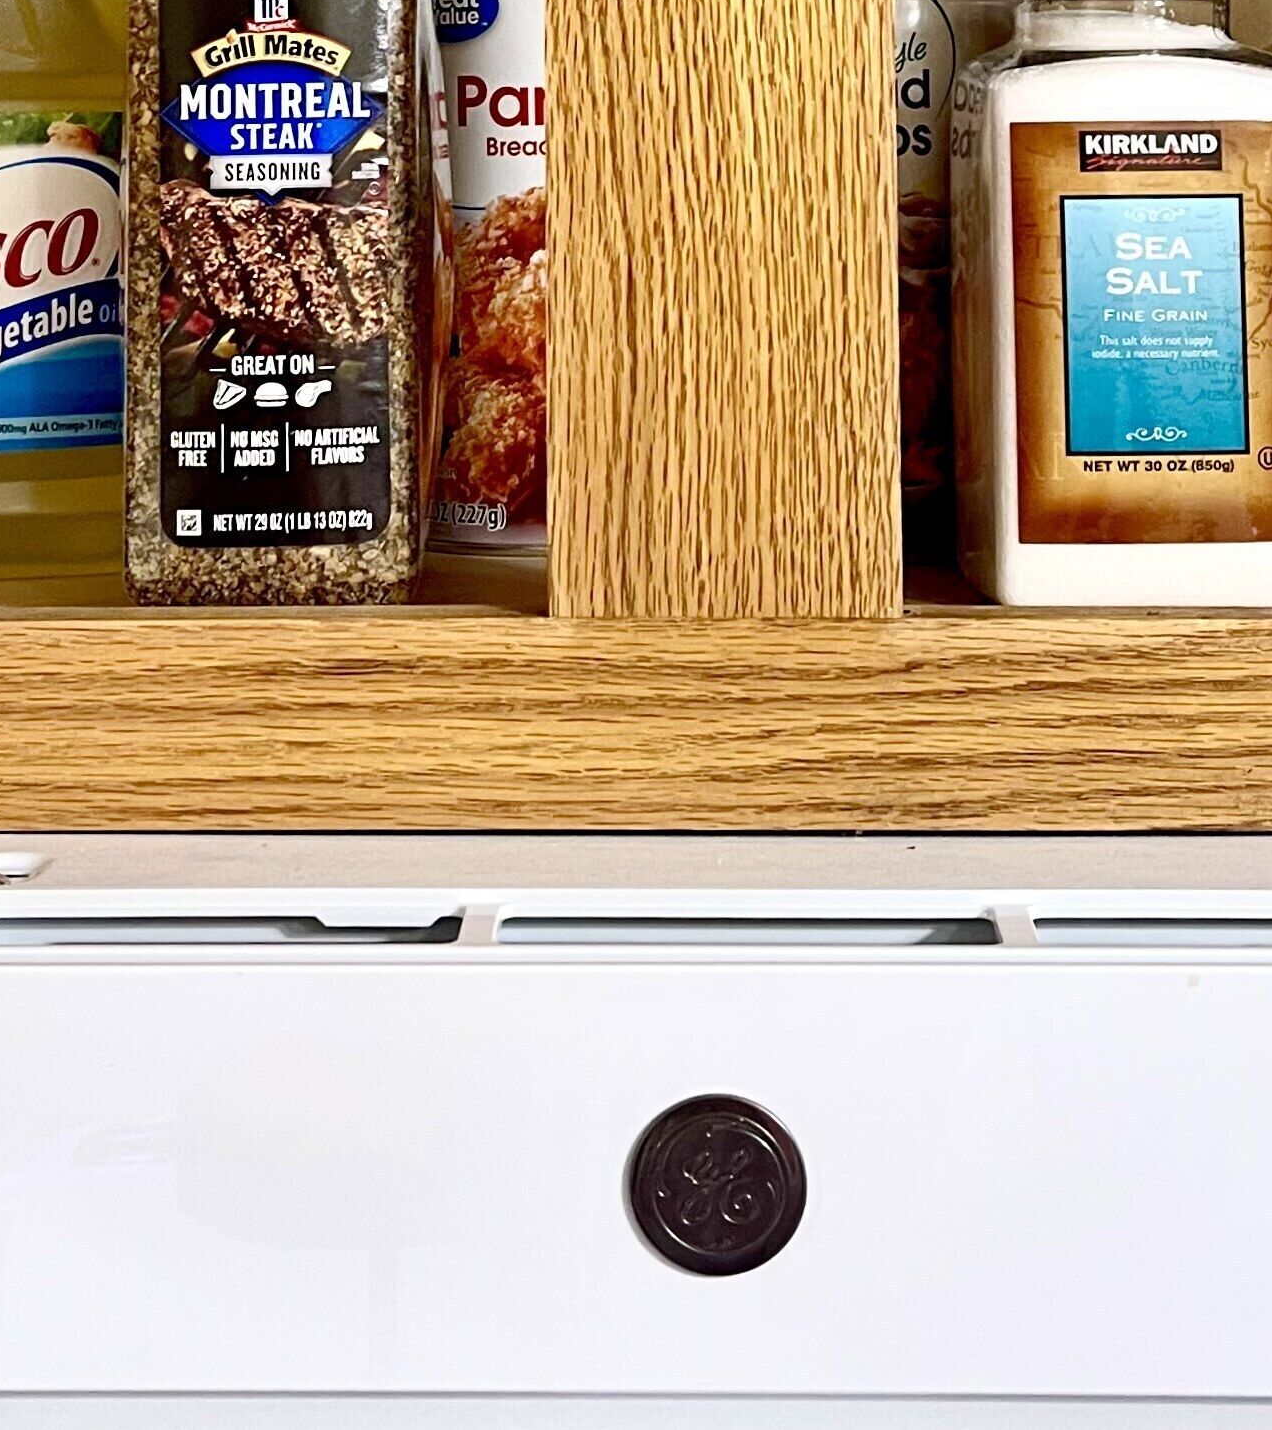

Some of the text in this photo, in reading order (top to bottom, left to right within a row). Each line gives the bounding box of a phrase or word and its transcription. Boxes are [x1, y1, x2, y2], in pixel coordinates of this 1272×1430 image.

[204, 33, 339, 68] Grill Mates
[180, 81, 371, 121] MONTREAL
[230, 123, 314, 150] STEAK
[1085, 134, 1218, 154] KIRKLAND
[224, 162, 321, 182] SEASONING
[1115, 232, 1192, 260] SEA
[1106, 266, 1203, 295] SALT
[99, 303, 122, 323] oi
[1103, 308, 1208, 323] FINE GRAIN
[1140, 335, 1163, 346] does
[1164, 336, 1182, 346] not
[231, 354, 315, 376] GREAT ON
[1133, 350, 1179, 361] necessary
[29, 422, 49, 432] ALA
[294, 426, 380, 447] NO ARTIFICIAL
[170, 431, 216, 449] GLUTEN
[230, 430, 279, 448] NO MSG
[178, 450, 207, 467] FREE
[234, 449, 275, 467] ADDED
[311, 446, 365, 466] FLAVORS
[1083, 460, 1112, 472] NET
[1117, 460, 1140, 472] WT
[1145, 460, 1162, 472] 30
[1167, 460, 1187, 472] OZ
[213, 513, 233, 532] NET
[235, 513, 253, 531] WT
[255, 513, 268, 531] 29
[269, 512, 282, 531] OZ
[297, 512, 311, 530] LB
[314, 511, 326, 530] 13
[329, 510, 346, 532] OZ)
[452, 503, 506, 530] (227g)
